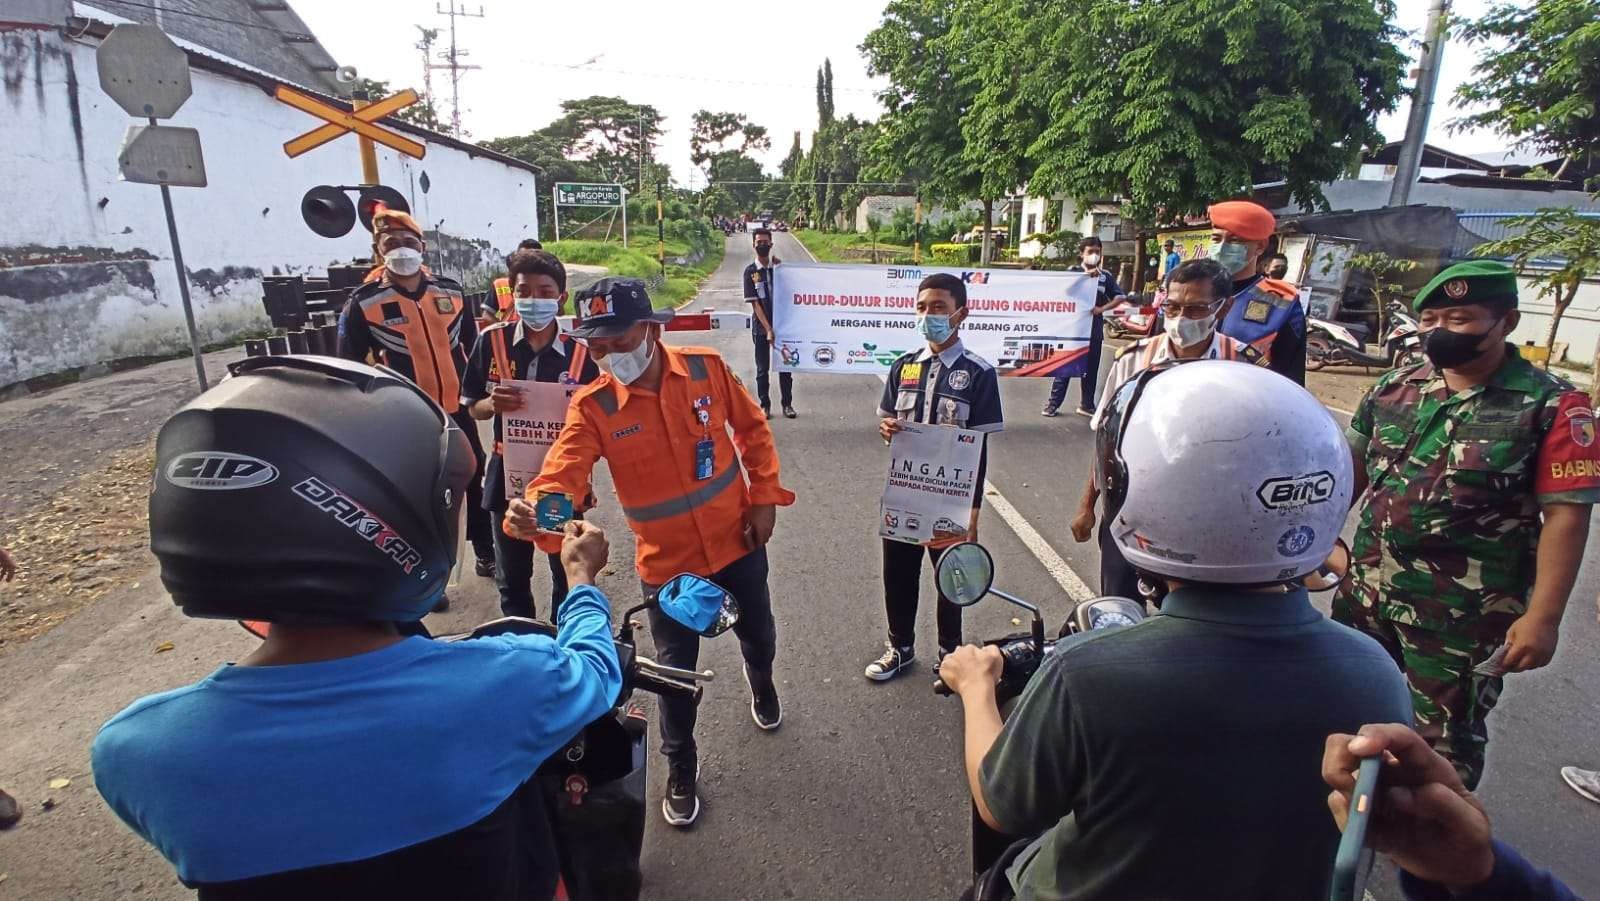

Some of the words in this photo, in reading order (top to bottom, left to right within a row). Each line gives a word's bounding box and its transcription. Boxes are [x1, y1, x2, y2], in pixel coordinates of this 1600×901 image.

[576, 192, 619, 200] ARGOPURO
[579, 294, 614, 319] KAI
[793, 294, 881, 308] DULUR-DULUR
[884, 297, 914, 308] ISUN
[967, 299, 1010, 312] ULUNG
[1013, 300, 1076, 313] NGANTENI
[831, 318, 881, 328] MERGANE
[884, 320, 916, 329] HANG
[968, 322, 1010, 332] BARANG
[1013, 324, 1039, 332] ATOS
[508, 418, 544, 429] KEPALA
[508, 428, 542, 438] LEBIH
[958, 434, 976, 444] KAI
[890, 479, 920, 490] DARIPADA
[922, 484, 944, 494] DICIUM
[946, 488, 970, 498] KERETA
[924, 477, 948, 486] DICIUM
[950, 481, 972, 490] PACAR
[291, 476, 422, 574] DAKKAR
